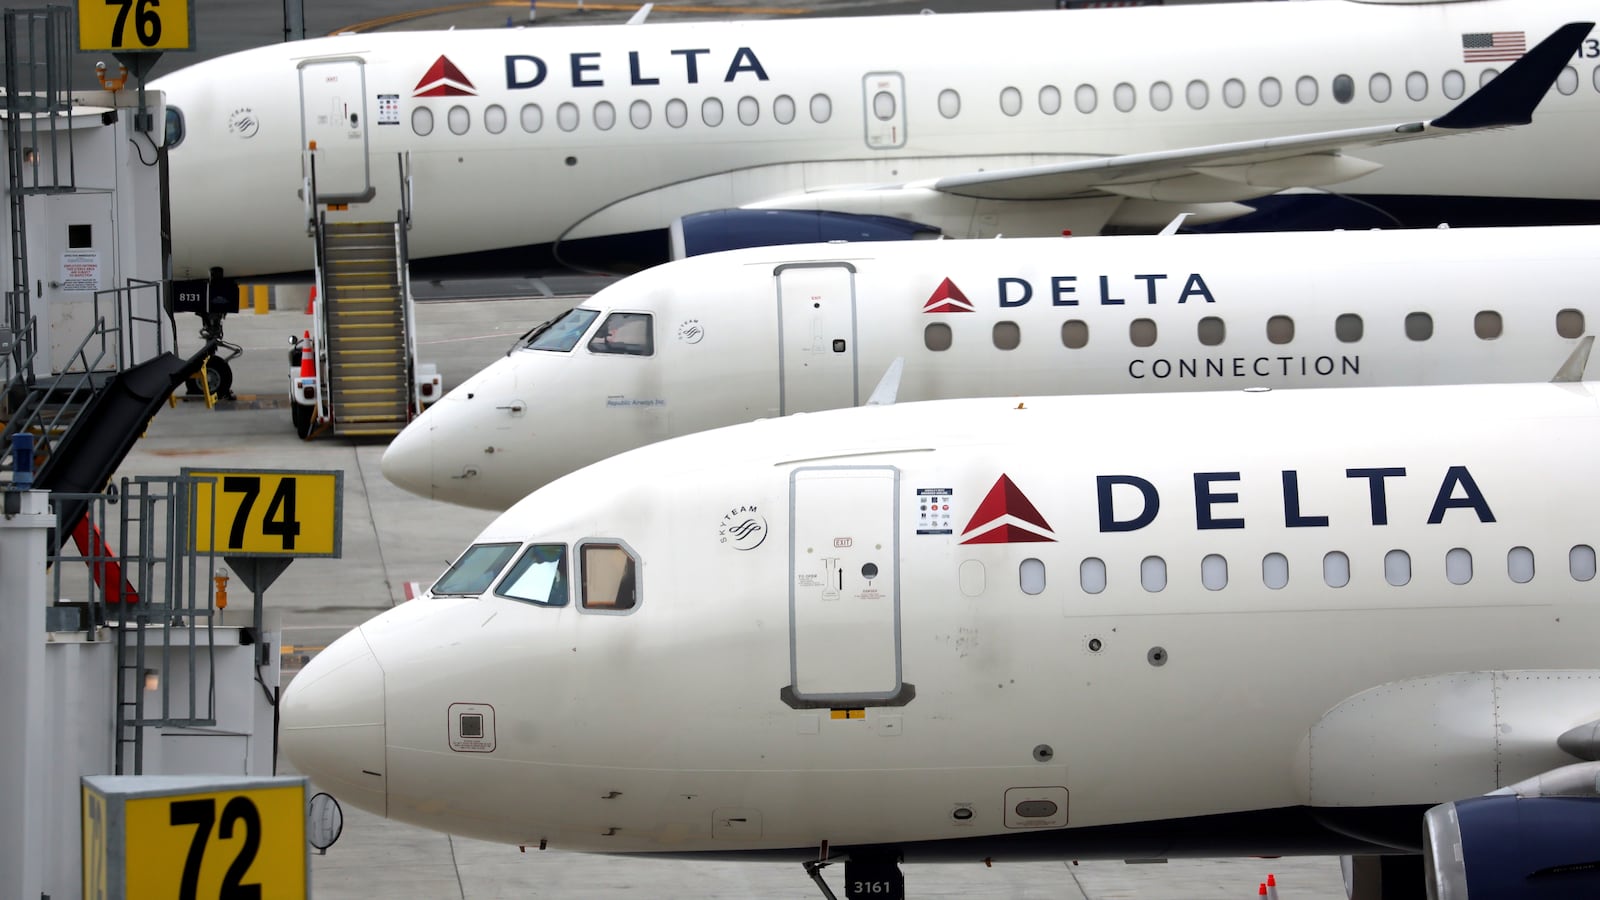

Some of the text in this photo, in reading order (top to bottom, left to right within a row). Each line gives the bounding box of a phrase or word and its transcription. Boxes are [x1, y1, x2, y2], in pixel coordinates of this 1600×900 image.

[106, 0, 161, 47] 76
[506, 47, 769, 89] DELTA
[179, 293, 201, 302] 8131
[998, 273, 1216, 308] DELTA
[1128, 355, 1361, 380] CONNECTION
[223, 477, 300, 550] 74
[1096, 466, 1496, 533] DELTA
[719, 505, 757, 544] SKYTEAM
[170, 796, 262, 900] 72
[854, 881, 890, 893] 3161
